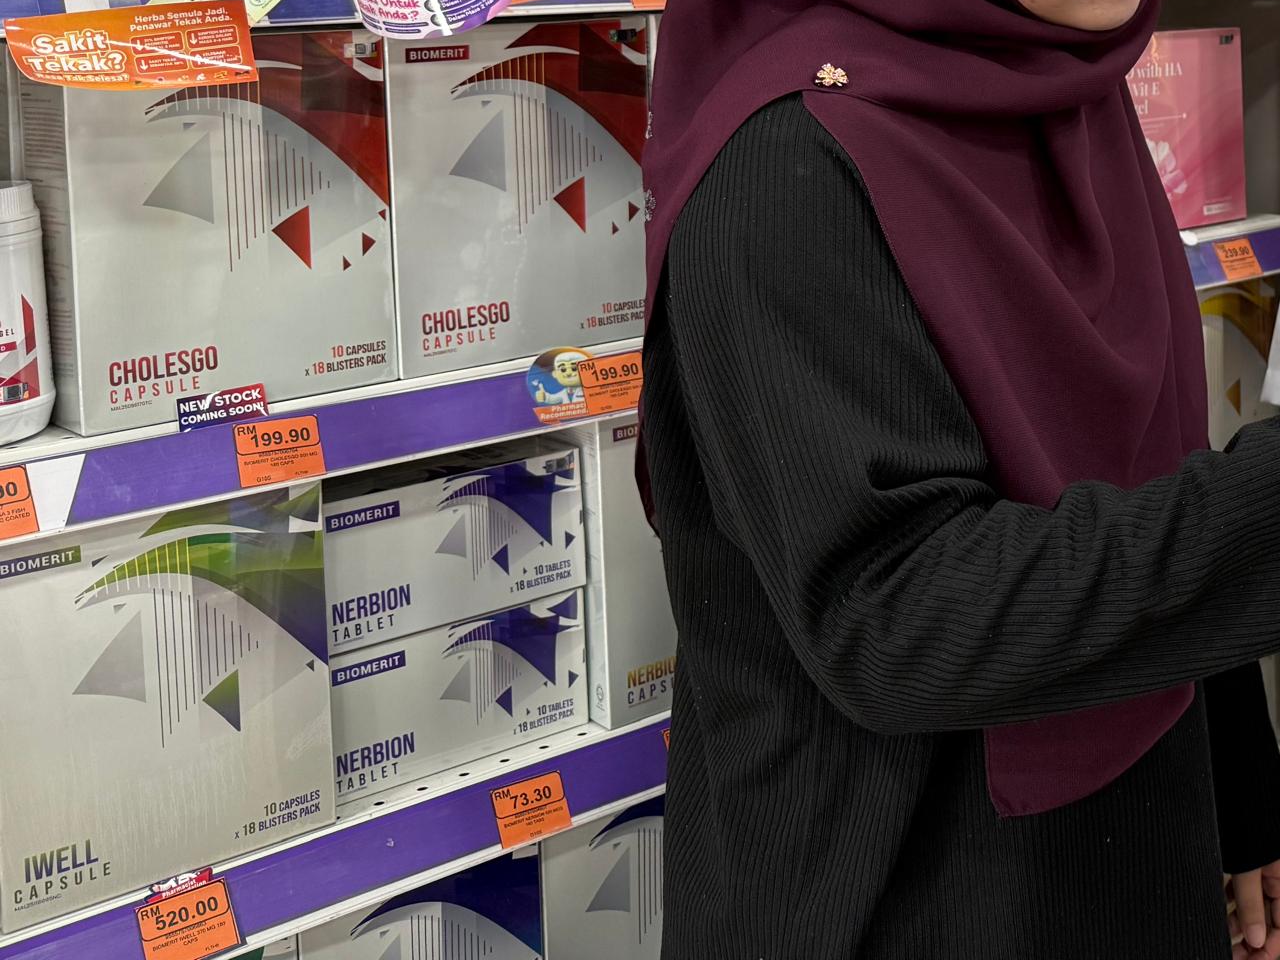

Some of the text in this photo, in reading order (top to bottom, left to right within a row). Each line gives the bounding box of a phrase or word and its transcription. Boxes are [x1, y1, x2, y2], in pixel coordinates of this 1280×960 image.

[129, 14, 232, 32] Penawar Tekak Anda.
[134, 7, 228, 24] Herba Semula Jadi.
[33, 30, 107, 55] Sakit
[409, 48, 465, 60] BIOMERIT
[26, 52, 124, 73] Tekak?
[1136, 62, 1182, 78] with HA
[1152, 82, 1160, 95] E
[422, 301, 510, 335] CHOLESGO
[602, 302, 612, 314] 10
[586, 312, 628, 329] 18 BLISTERS
[331, 340, 386, 358] 10 CAPSULES
[423, 327, 496, 351] CAPSULE
[109, 345, 218, 386] CHOLESGO
[313, 352, 387, 375] 18 BLISTERS PACK
[580, 362, 639, 382] RM 199.90
[110, 376, 200, 403] CAPSULE
[180, 388, 261, 413] NEW STOCK
[181, 402, 265, 425] COMING SOON!
[237, 425, 310, 448] RM 199.90
[5, 512, 30, 521] COATED
[330, 505, 395, 528] BIOMERIT
[1, 550, 75, 574] BIOMERIT
[534, 559, 571, 576] 10 TABLETS
[515, 569, 572, 591] 18 BLISTERS PACK
[332, 583, 412, 626] NERBION
[332, 614, 395, 643] TABLET
[336, 656, 400, 682] BIOMERIT
[537, 698, 573, 716] 10 TABLETS
[518, 709, 574, 733] 18 BLISTERS PACK
[336, 732, 415, 777] NERBION
[336, 762, 399, 794] TABLET
[264, 789, 320, 816] 10 CAPSULES
[494, 786, 551, 809] RM 73.30
[242, 803, 321, 837] 18 BLISTERS PACK
[24, 839, 99, 884] IWELL
[13, 861, 112, 905] CAPSULE
[140, 896, 218, 930] RM 520.00
